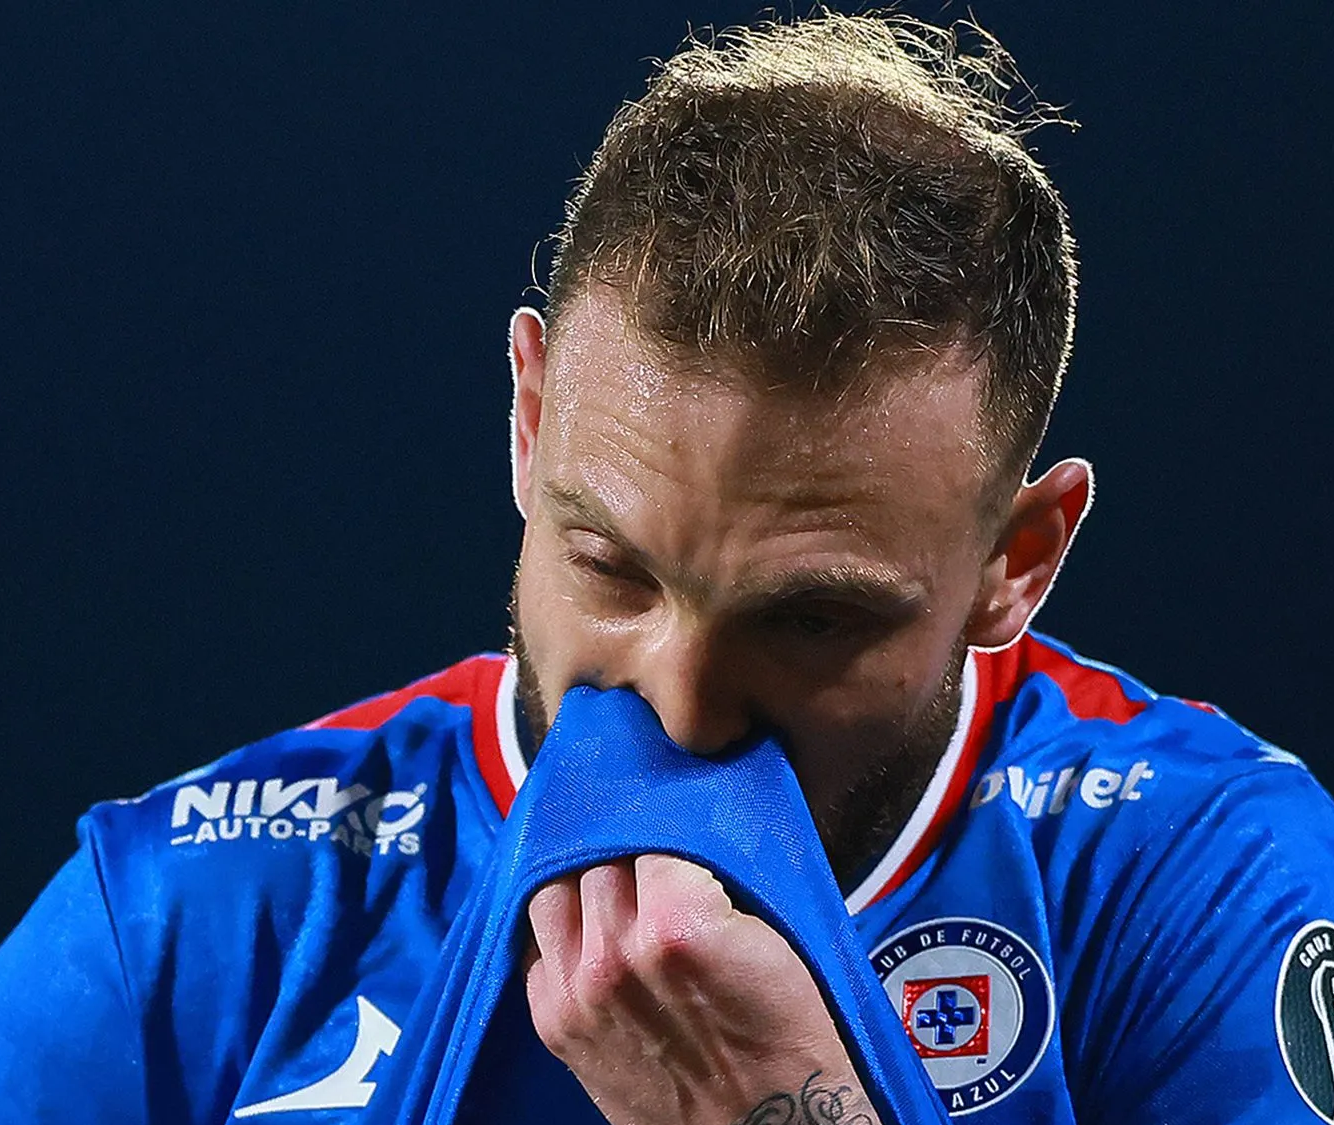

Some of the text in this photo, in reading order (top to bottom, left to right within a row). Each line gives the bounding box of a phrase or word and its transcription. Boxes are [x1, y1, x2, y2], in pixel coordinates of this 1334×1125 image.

[919, 929, 946, 947] DE
[961, 928, 1032, 981] FUTBOL
[1298, 932, 1332, 969] CRUZ
[951, 1069, 1017, 1109] AZUL
